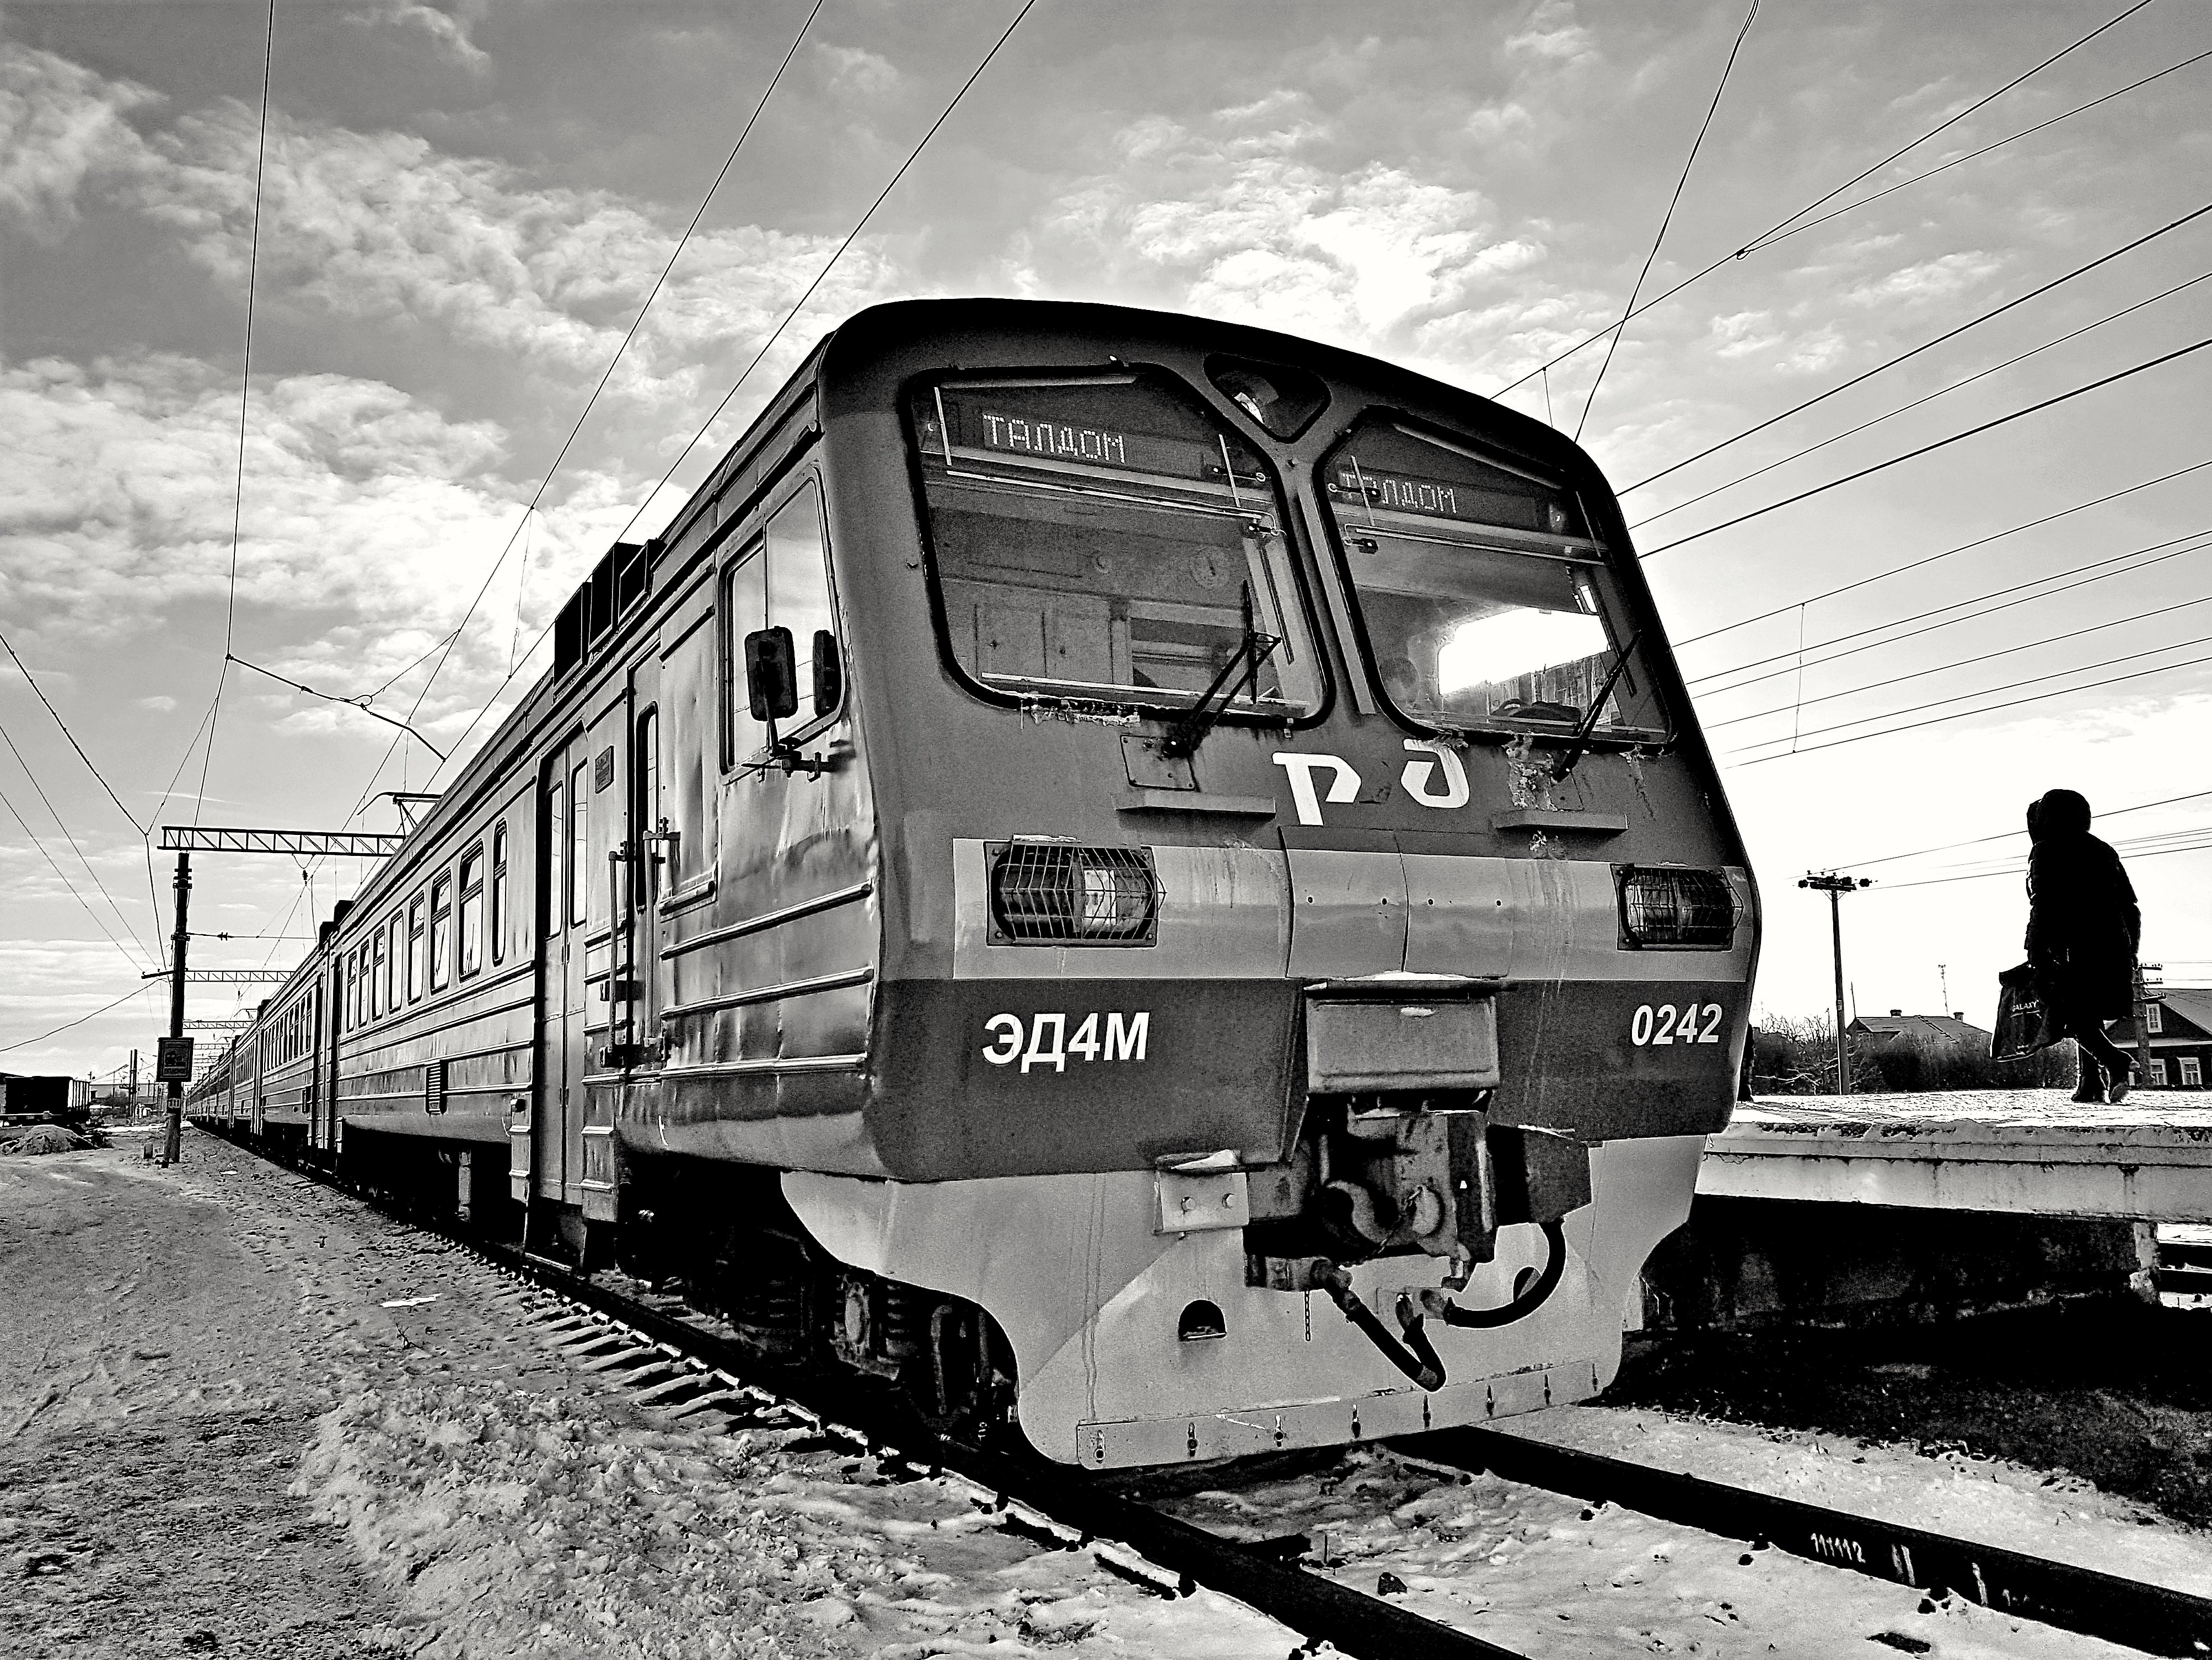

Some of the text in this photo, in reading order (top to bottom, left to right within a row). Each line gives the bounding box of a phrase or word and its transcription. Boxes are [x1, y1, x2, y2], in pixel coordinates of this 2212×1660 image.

[983, 414, 1125, 464] ТАЛДОМ
[982, 1012, 1151, 1073] ЭД4М
[1631, 1003, 1723, 1047] 0242
